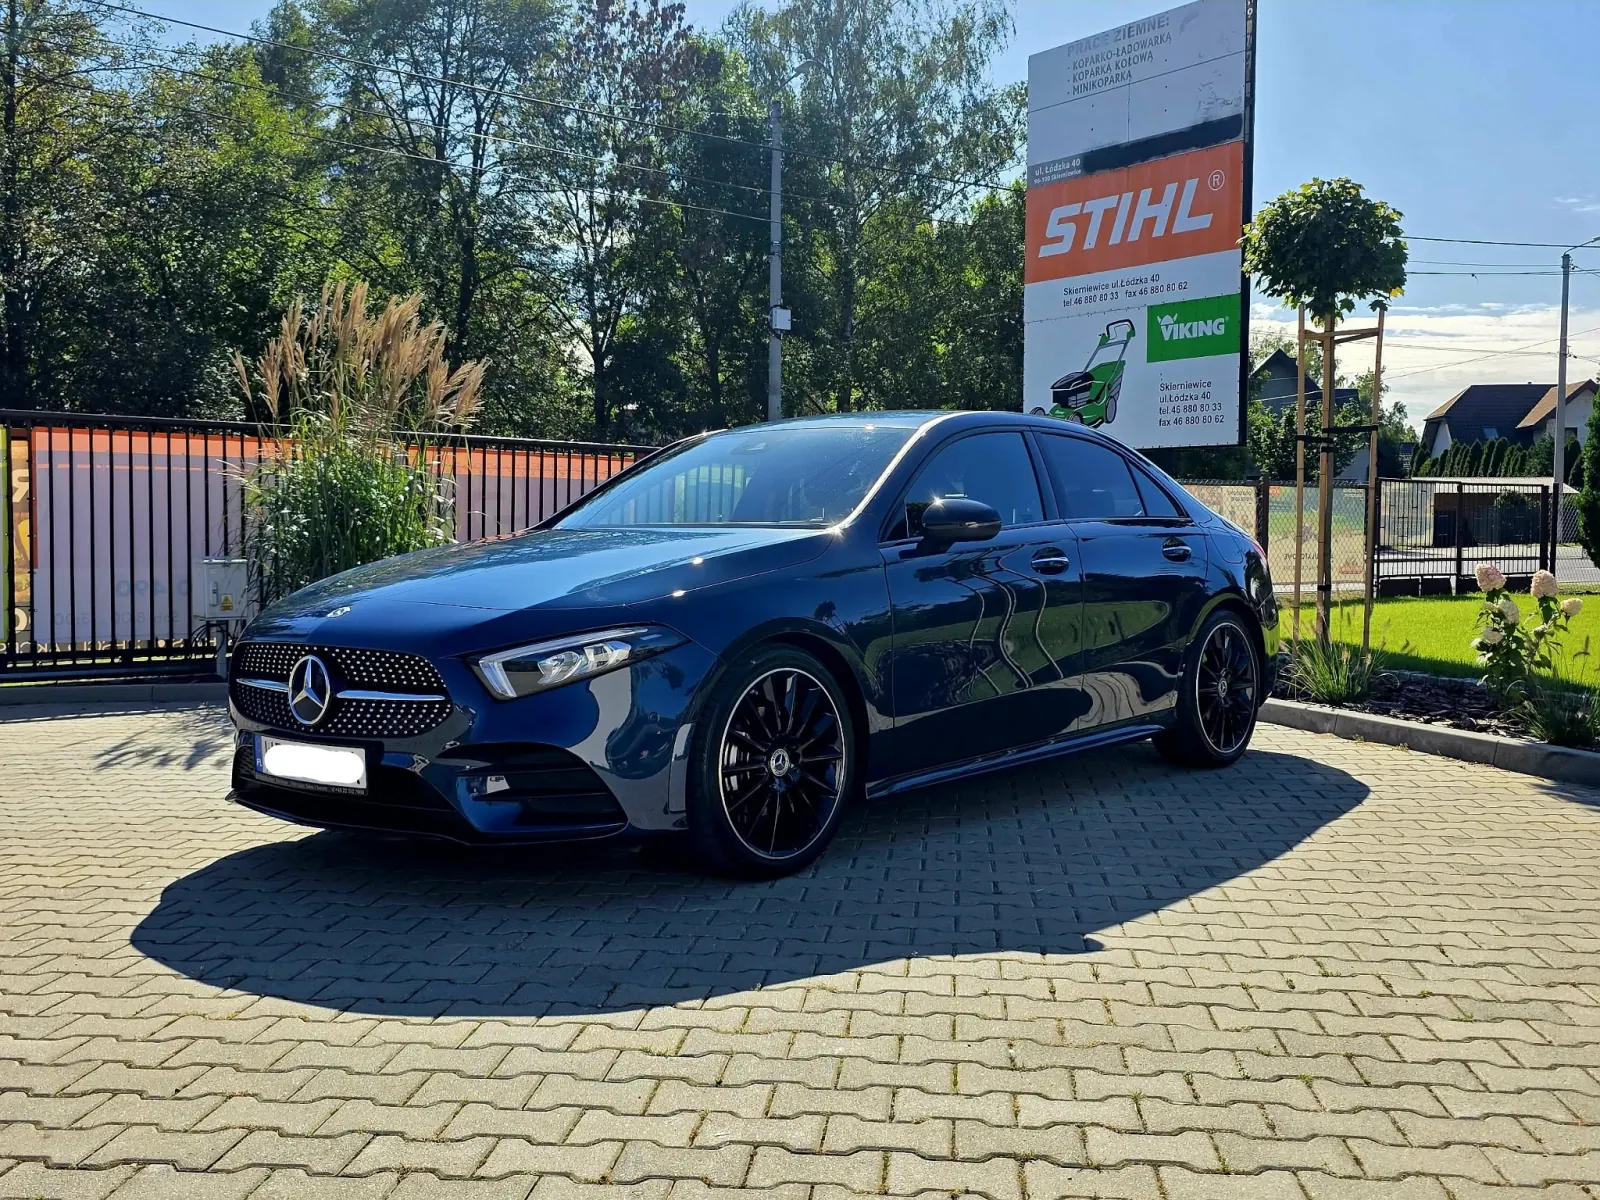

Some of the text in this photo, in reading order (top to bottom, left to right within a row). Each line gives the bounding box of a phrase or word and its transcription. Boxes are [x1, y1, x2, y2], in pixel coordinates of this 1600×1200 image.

[1071, 158, 1081, 167] 40
[1038, 178, 1213, 258] STIHL
[1063, 281, 1110, 296] Skierniewice
[1150, 273, 1160, 282] 40
[1084, 294, 1097, 304] 880
[1099, 293, 1108, 302] 80
[1110, 291, 1119, 301] 33
[1125, 289, 1137, 298] fax
[1138, 286, 1148, 296] 46
[1150, 284, 1164, 295] 880
[1166, 282, 1176, 292] 80
[1178, 281, 1188, 291] 62
[1160, 317, 1225, 341] VIKING
[1159, 379, 1212, 392] Skierniewice
[1200, 391, 1211, 400] 40
[1183, 404, 1198, 413] 880
[1200, 403, 1210, 412] 80
[1212, 402, 1222, 412] 33
[1158, 414, 1225, 427] fax 46 880 80 62
